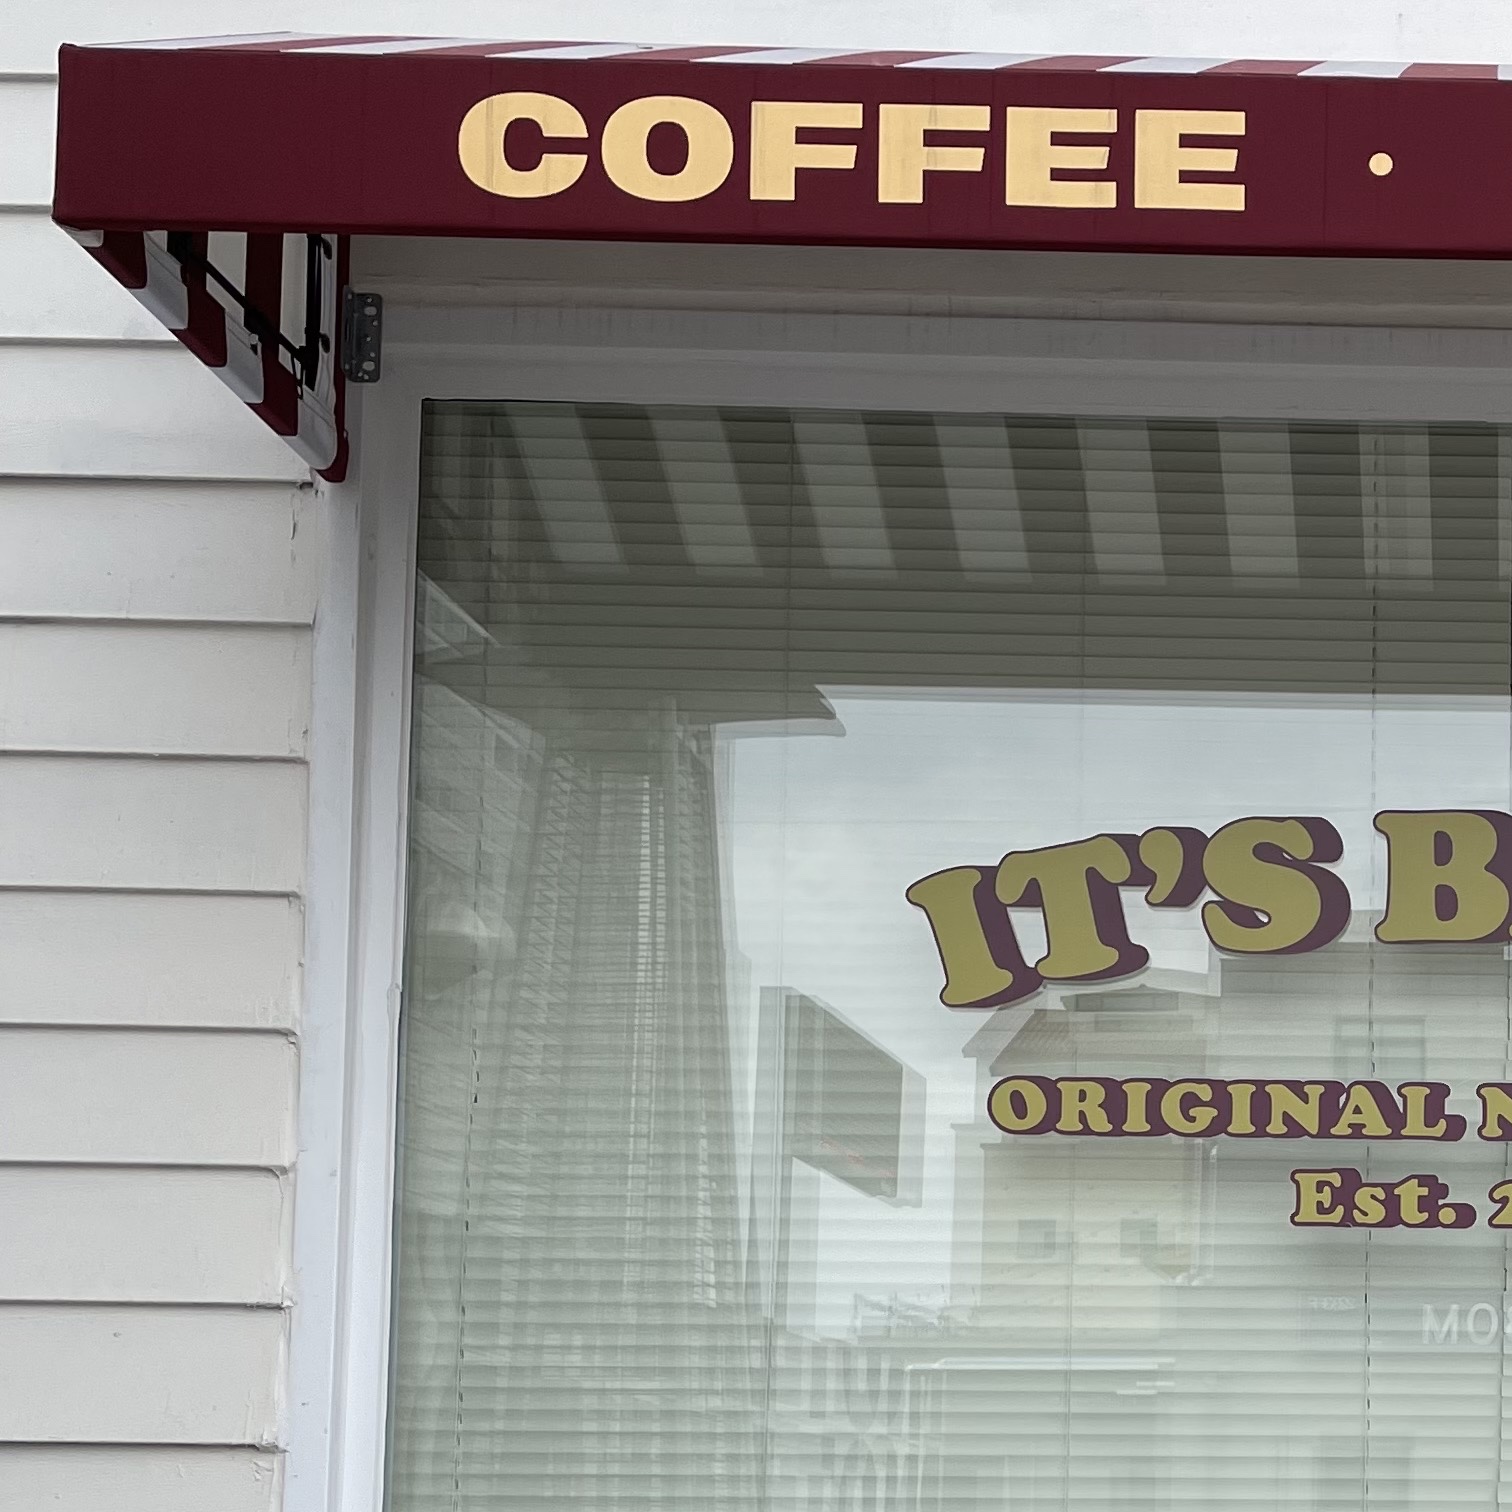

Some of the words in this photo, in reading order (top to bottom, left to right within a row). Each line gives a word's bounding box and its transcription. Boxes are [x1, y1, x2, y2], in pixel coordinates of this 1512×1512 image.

[457, 91, 1246, 212] COFFEE
[905, 816, 1351, 1008] IT'S
[987, 1076, 1467, 1141] ORIGINAL
[1290, 1168, 1476, 1230] Est.
